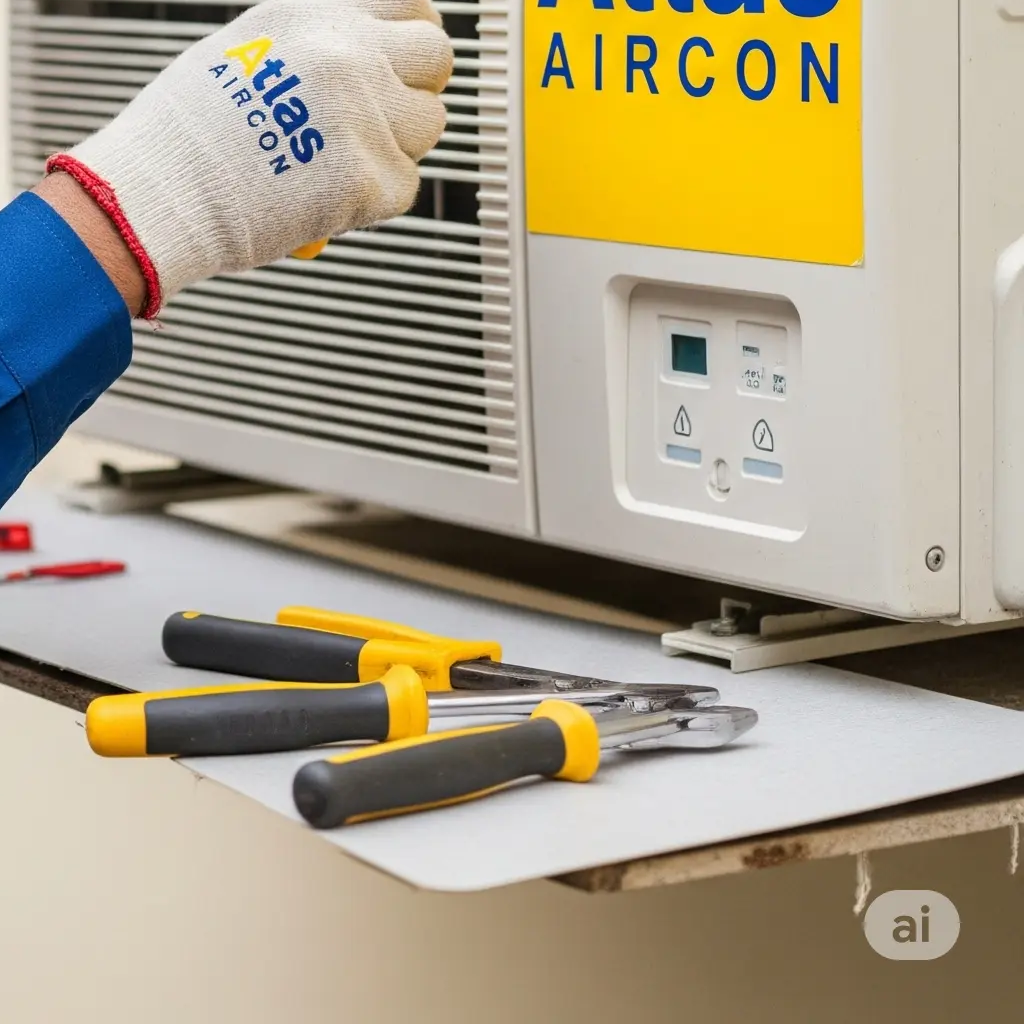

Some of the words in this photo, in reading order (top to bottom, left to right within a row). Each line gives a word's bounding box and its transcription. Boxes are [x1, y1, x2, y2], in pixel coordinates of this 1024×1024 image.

[208, 63, 292, 175] AIRCON
[223, 35, 325, 164] Atlas
[540, 31, 840, 104] AIRCON
